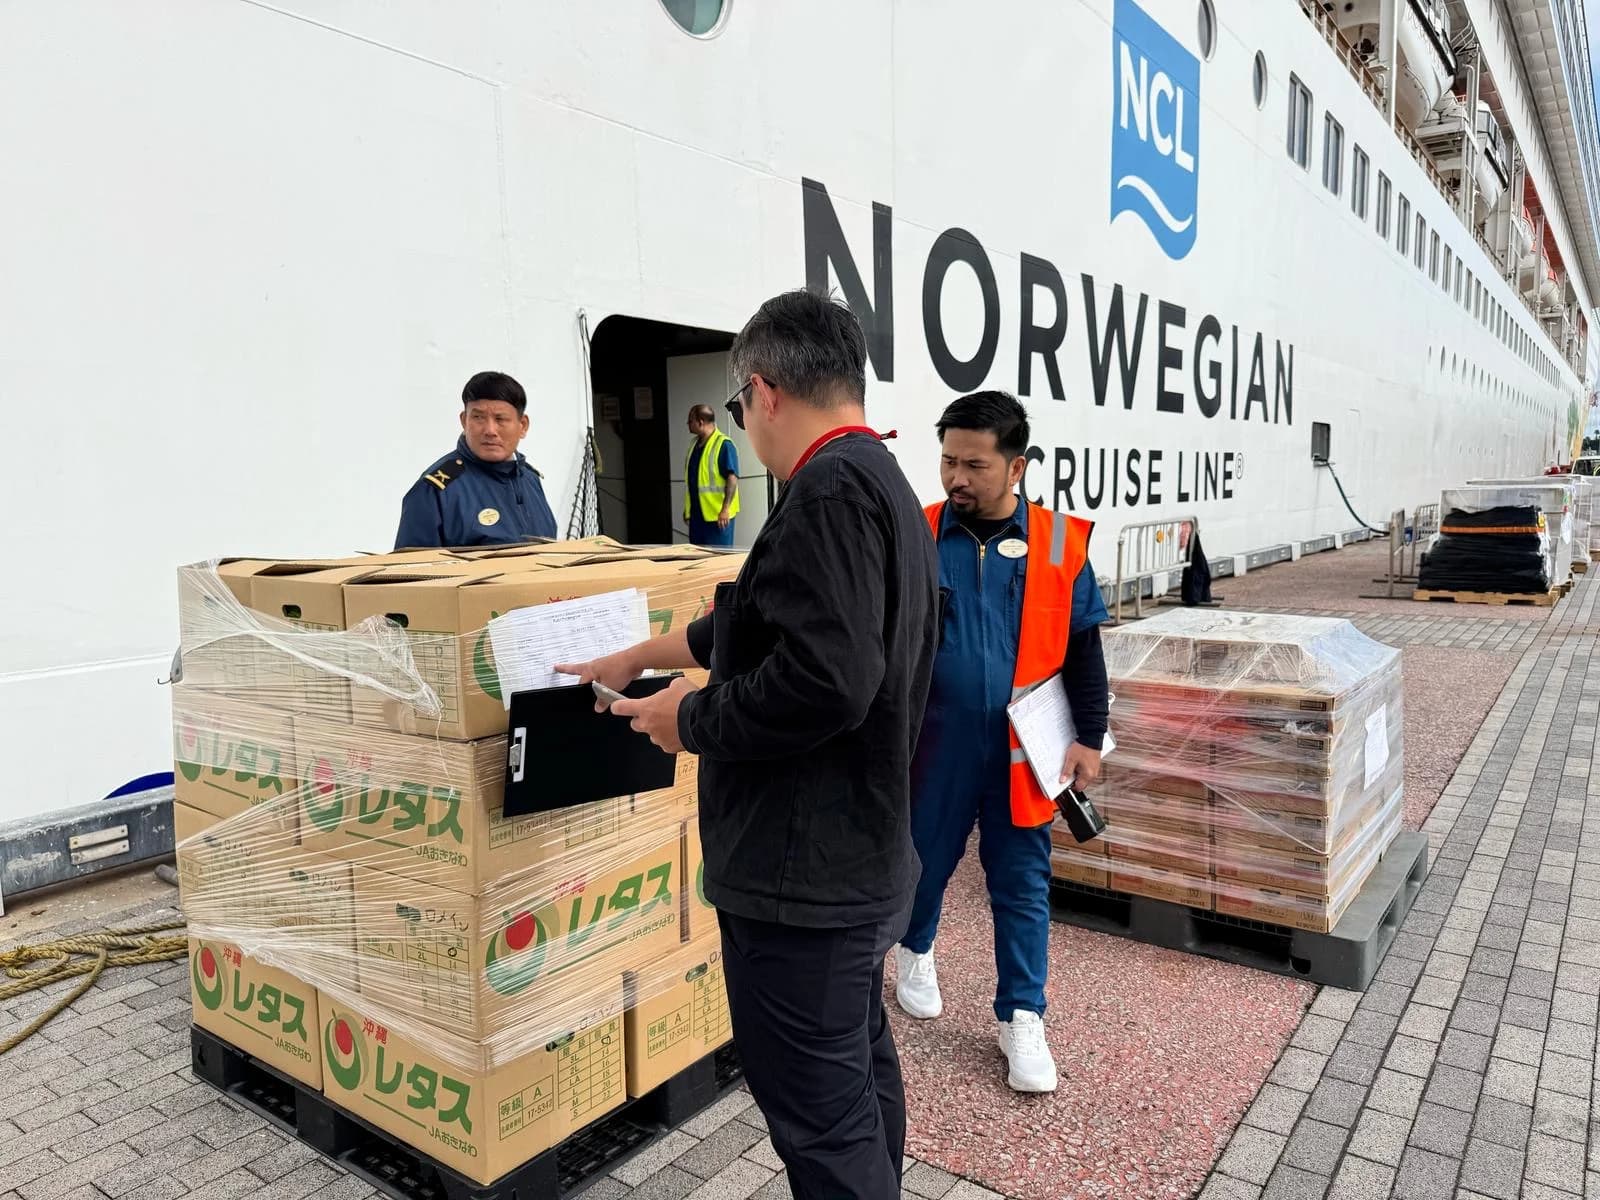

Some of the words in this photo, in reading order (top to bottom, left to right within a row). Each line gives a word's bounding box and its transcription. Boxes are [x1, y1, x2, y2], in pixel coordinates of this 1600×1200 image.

[1120, 40, 1194, 173] NCL
[802, 176, 1294, 426] NORWEGIAN
[1019, 445, 1163, 512] CRUISE
[358, 773, 464, 844] レタス
[566, 861, 673, 951] レタス
[233, 968, 308, 1043] レタス
[363, 1017, 388, 1045] 沖縄
[375, 1045, 473, 1136] レタス
[533, 1086, 542, 1100] A
[428, 1125, 479, 1158] JAおきなわ
